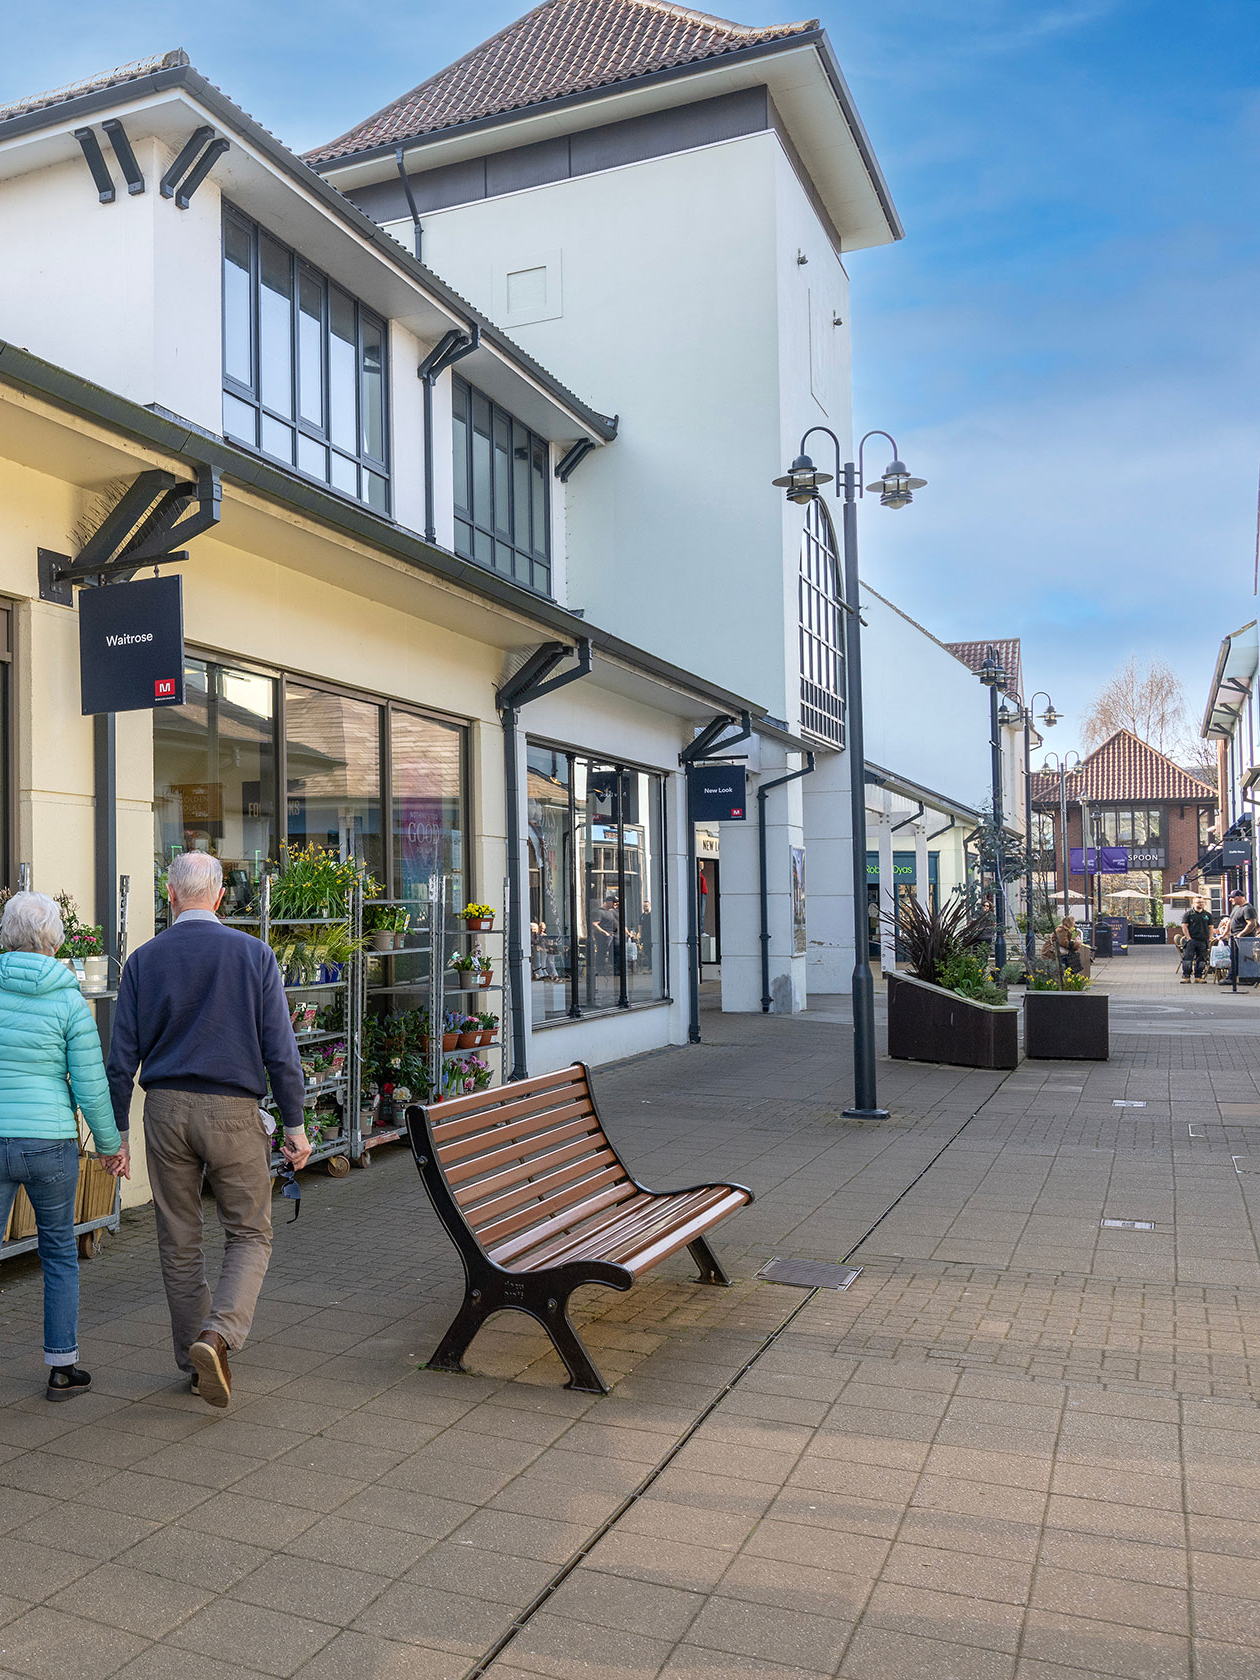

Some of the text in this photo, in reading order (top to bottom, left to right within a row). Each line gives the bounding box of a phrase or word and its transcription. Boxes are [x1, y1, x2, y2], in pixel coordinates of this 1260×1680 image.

[105, 632, 154, 647] Waitrose
[159, 682, 171, 693] M
[407, 821, 440, 844] GOOD
[702, 839, 715, 853] NEW
[893, 864, 913, 876] Dyas
